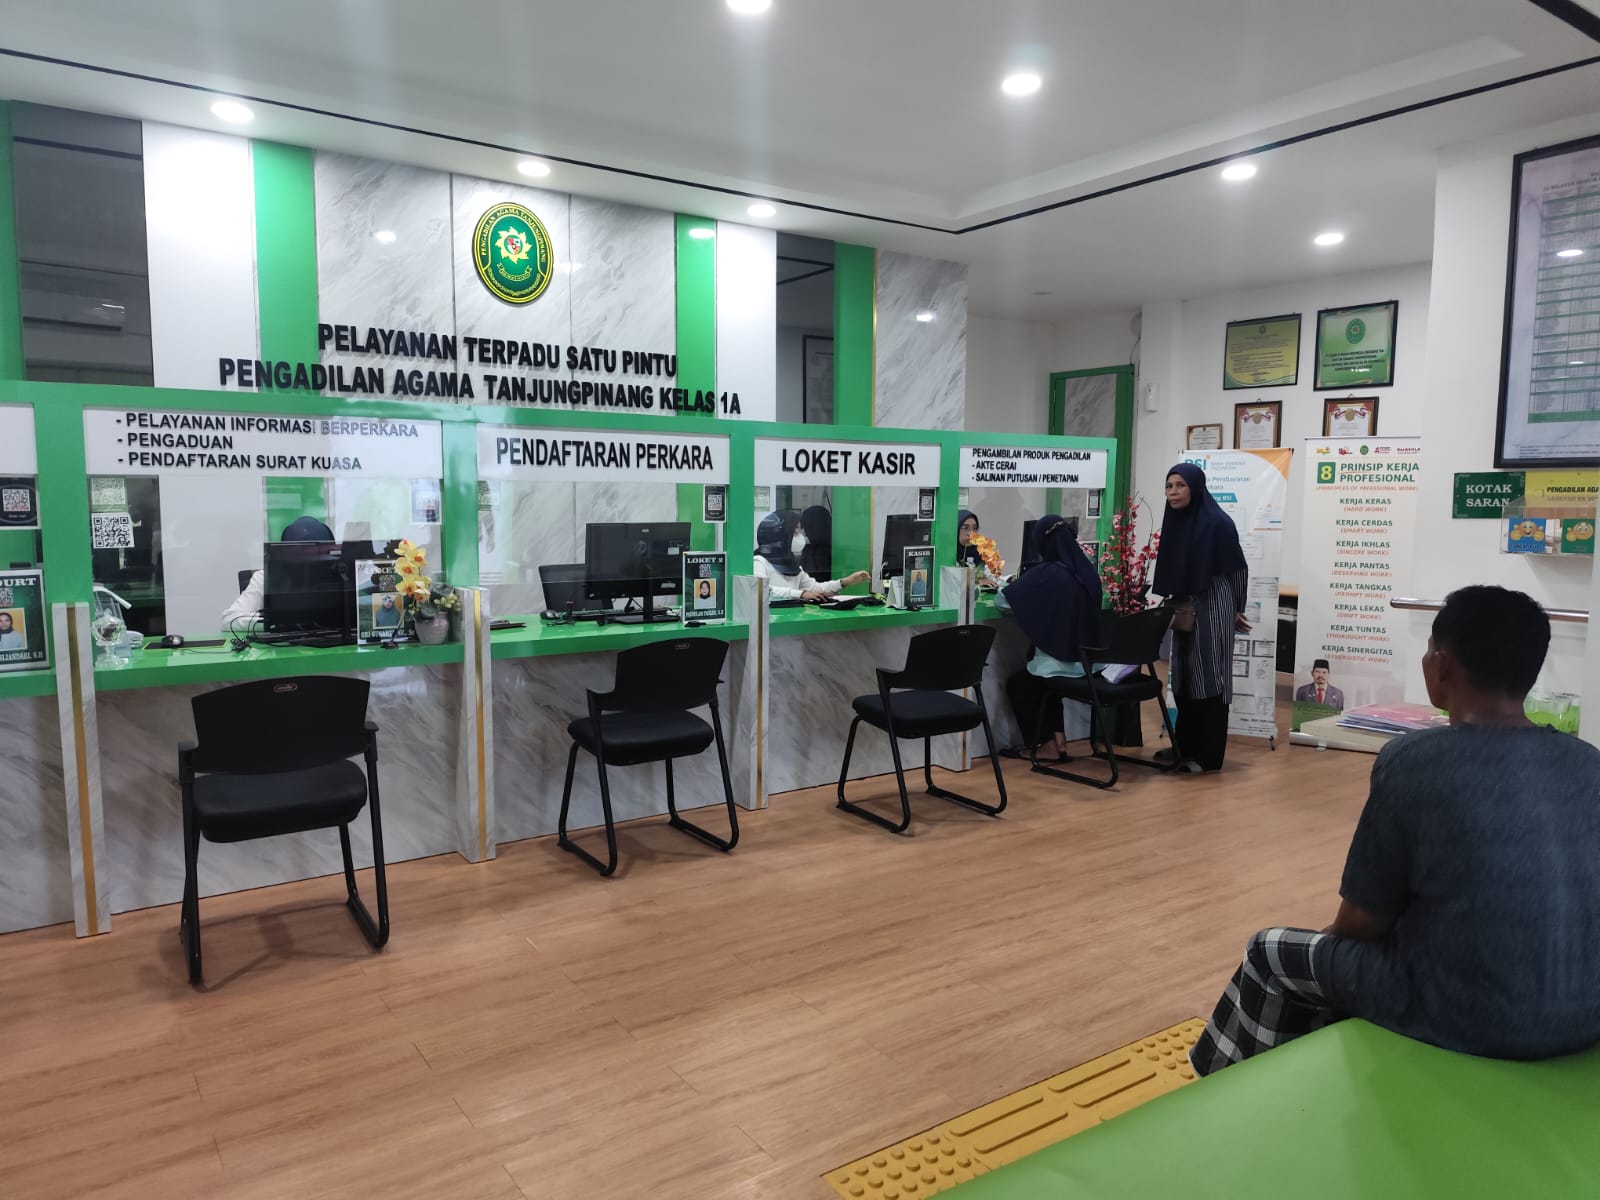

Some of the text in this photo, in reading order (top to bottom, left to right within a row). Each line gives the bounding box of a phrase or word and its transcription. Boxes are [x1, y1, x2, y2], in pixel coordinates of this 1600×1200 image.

[318, 323, 677, 378] PELAYANAN TERPADU SATU PINTU
[219, 357, 742, 415] PENGADILAN AGAMA TANJUNGPINANG KELAS 1A
[126, 412, 226, 431] PELAYANAN
[230, 417, 317, 435] INFORMASI
[320, 419, 419, 438] BERPERKARA
[127, 432, 234, 450] PENGADUAN
[496, 437, 714, 471] PENDAFTARAN PERKARA
[972, 448, 1091, 461] PENGAMBILAN PRODUK PENGADILAN
[128, 452, 251, 469] PENDAFTARAN
[256, 454, 307, 470] SURAT
[311, 456, 362, 471] KUASA
[781, 448, 916, 476] LOKET KASIR
[975, 460, 995, 470] AKTE
[995, 461, 1017, 471] CERAI
[1340, 462, 1420, 473] PRINSIP KERJA
[975, 472, 1006, 482] SALINAN
[1007, 473, 1038, 483] PUTUSAN
[1320, 465, 1332, 481] 8
[1340, 474, 1416, 483] PROFESIONAL
[1465, 484, 1513, 494] KOTAK
[1465, 498, 1511, 508] SARAN
[1335, 604, 1385, 613] KERJA LEKAS
[1355, 626, 1387, 634] TUNTAS
[1322, 645, 1393, 656] KERJA SINERGITAS
